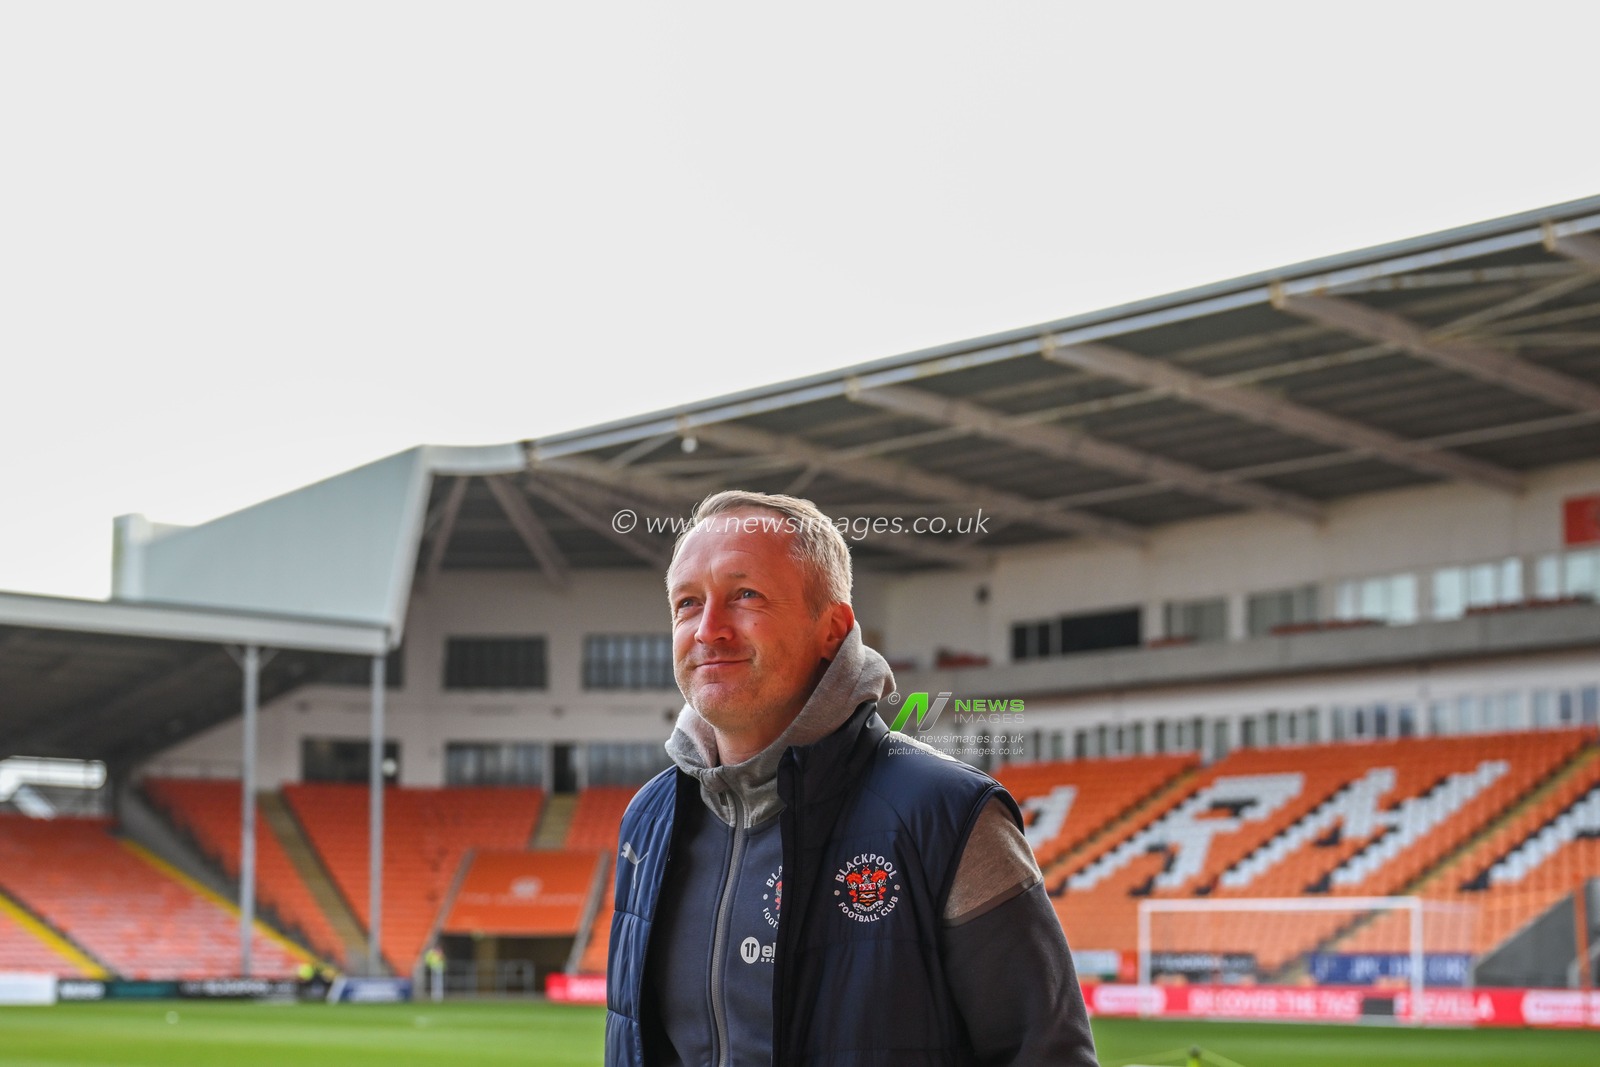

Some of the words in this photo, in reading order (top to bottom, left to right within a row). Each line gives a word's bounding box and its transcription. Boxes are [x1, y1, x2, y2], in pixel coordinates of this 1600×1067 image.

[835, 853, 897, 883] BLACKPOOL
[838, 902, 880, 923] FOOTBALL
[880, 896, 899, 916] CLUB
